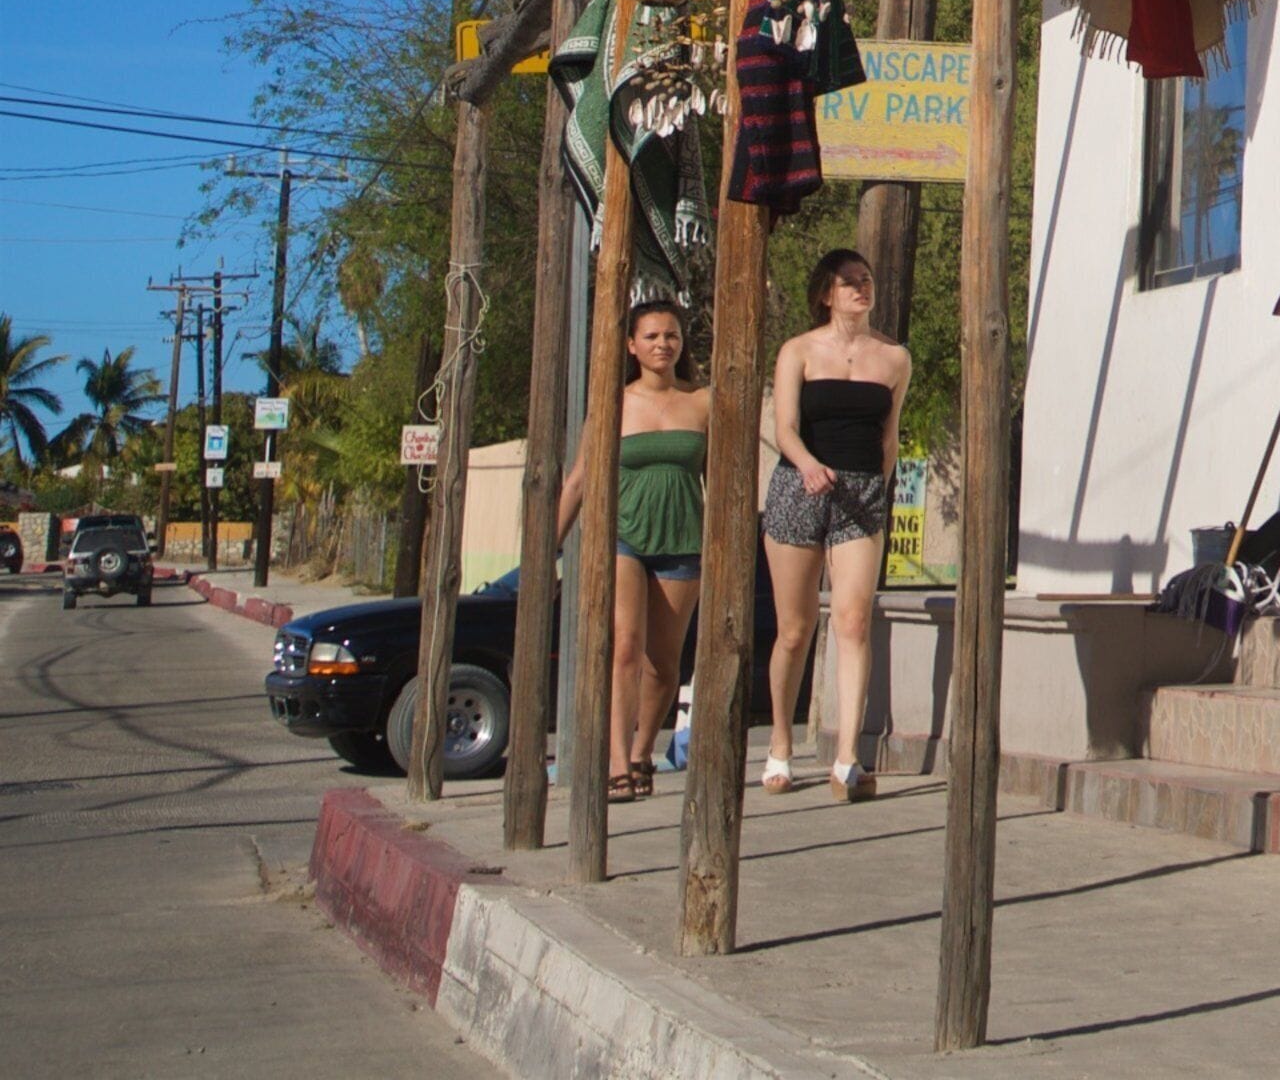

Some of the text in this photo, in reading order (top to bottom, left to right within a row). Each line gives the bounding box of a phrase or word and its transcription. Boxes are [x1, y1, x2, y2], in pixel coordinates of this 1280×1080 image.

[865, 51, 971, 84] NSCAPE
[823, 91, 966, 125] RV PARK
[888, 537, 920, 555] ORE
